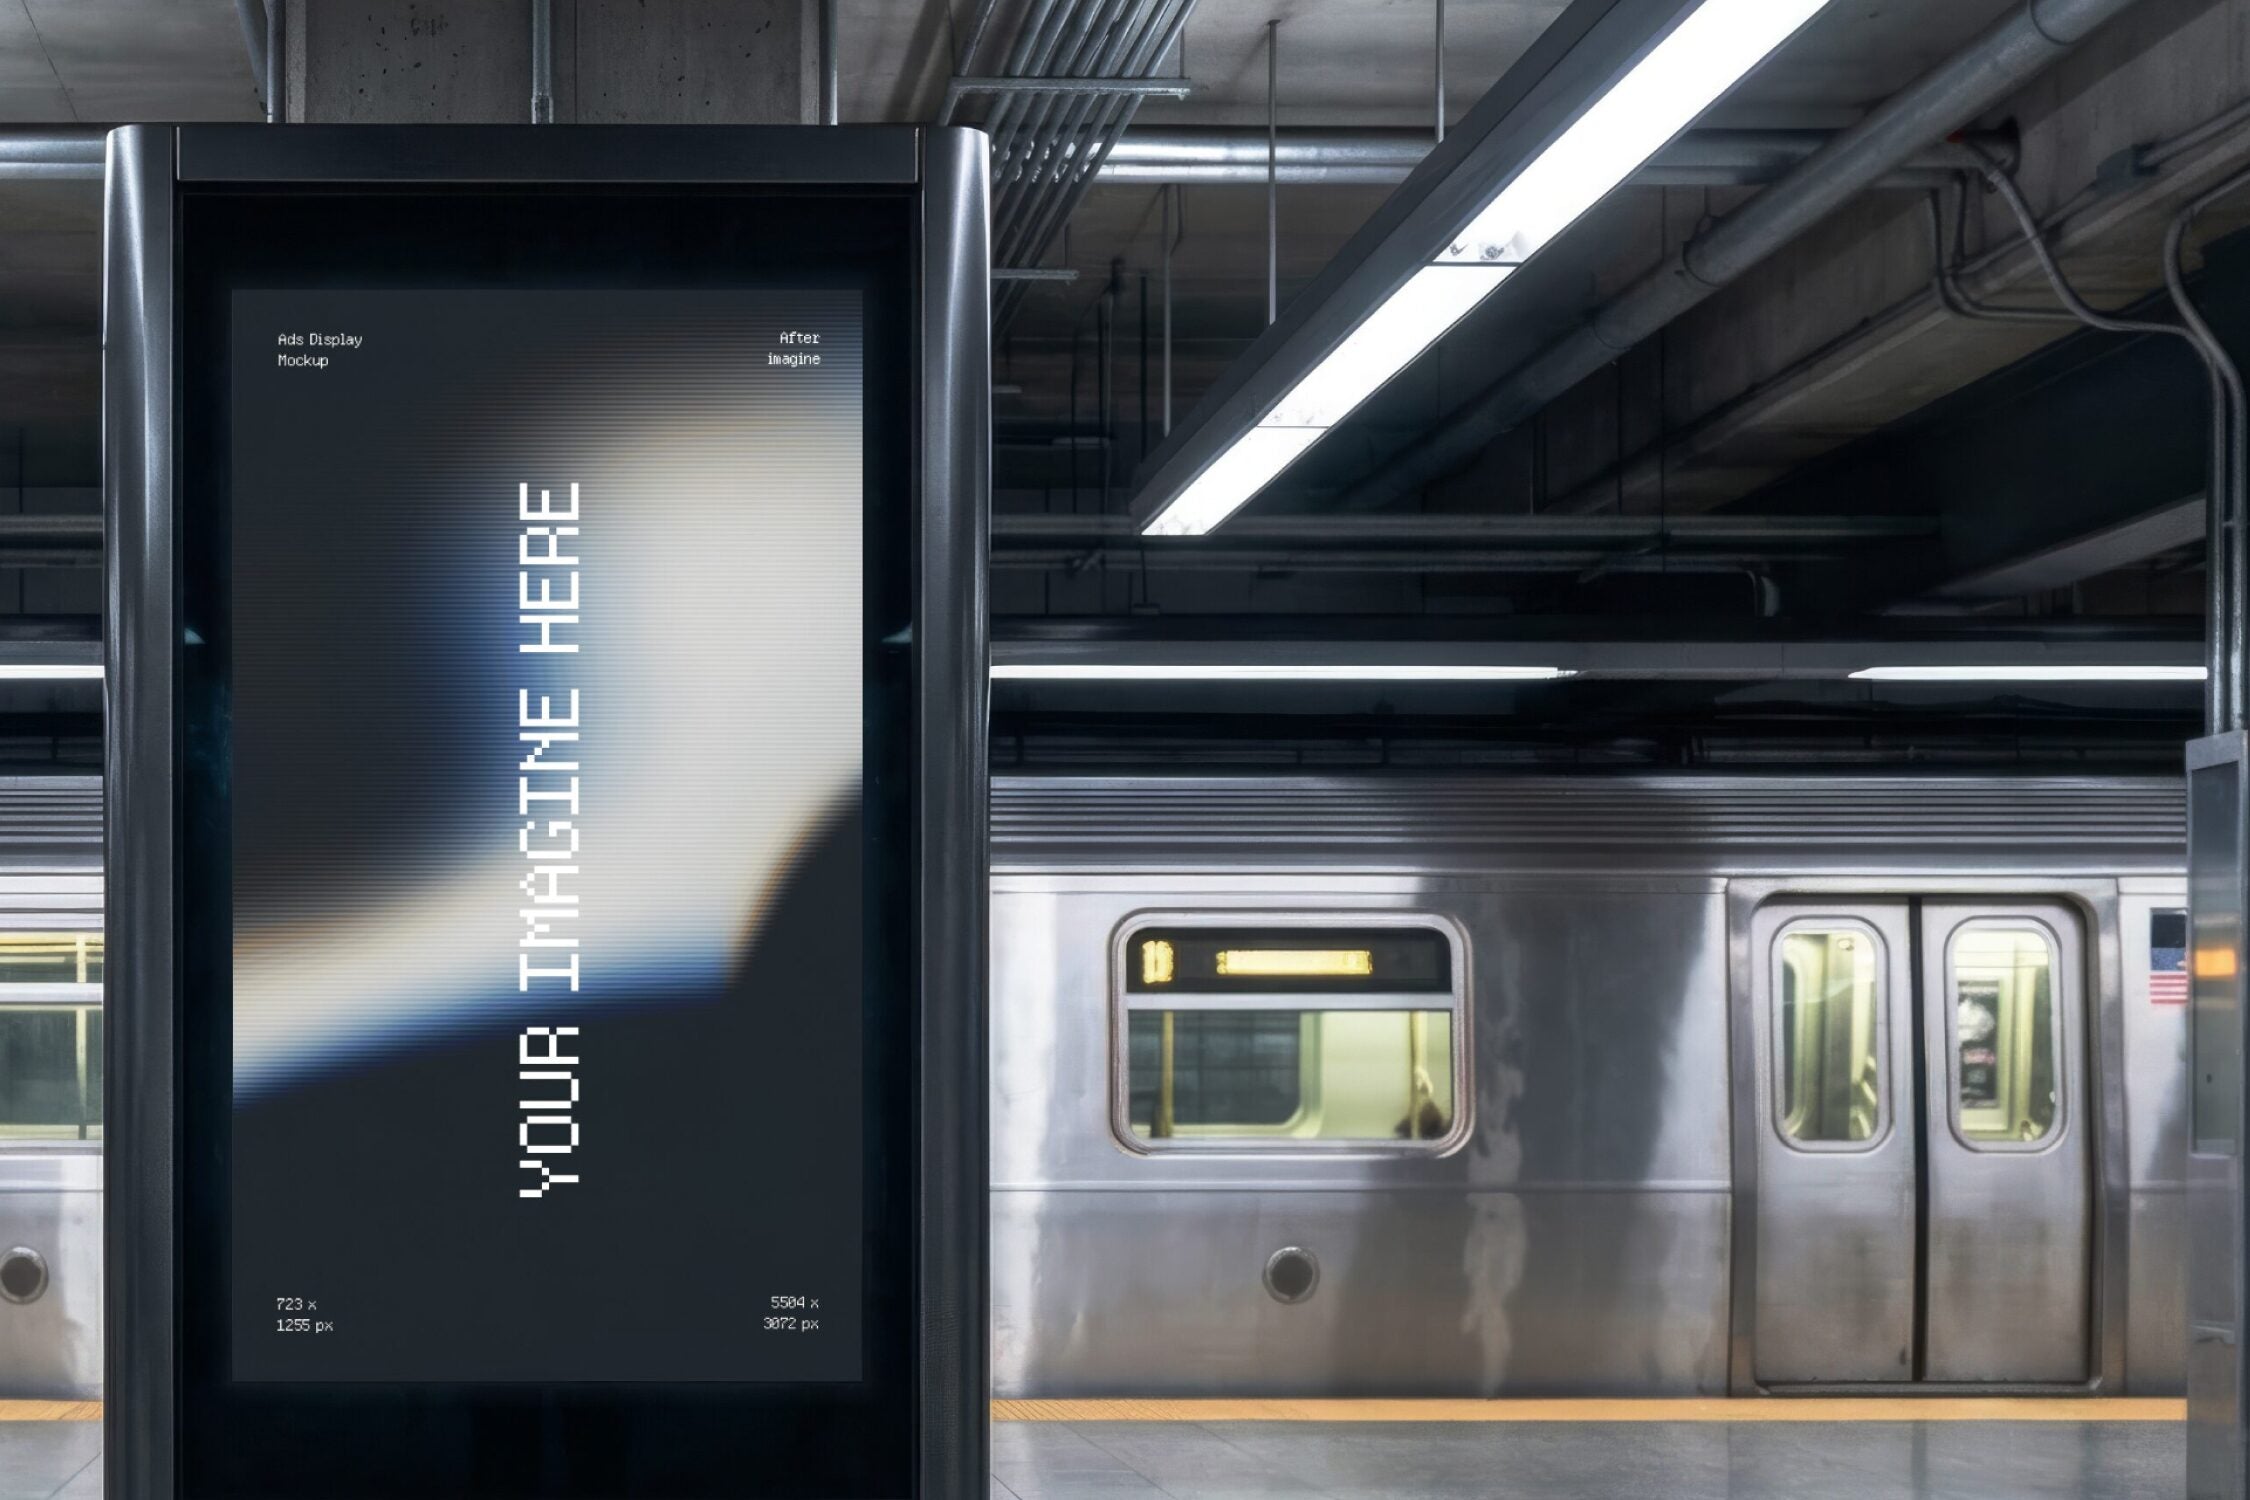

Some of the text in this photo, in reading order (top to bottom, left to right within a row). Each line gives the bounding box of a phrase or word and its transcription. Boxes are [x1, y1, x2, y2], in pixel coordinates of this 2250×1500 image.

[278, 332, 363, 349] Ads Display
[780, 331, 820, 344] After
[278, 353, 329, 369] Mockup
[768, 352, 821, 368] imagine
[519, 482, 580, 1198] YOUR IMAGINE HERE
[277, 1297, 317, 1311] 723 x
[771, 1296, 819, 1309] 5504 x
[277, 1318, 334, 1334] 1255 px
[763, 1316, 819, 1333] 3072 px
